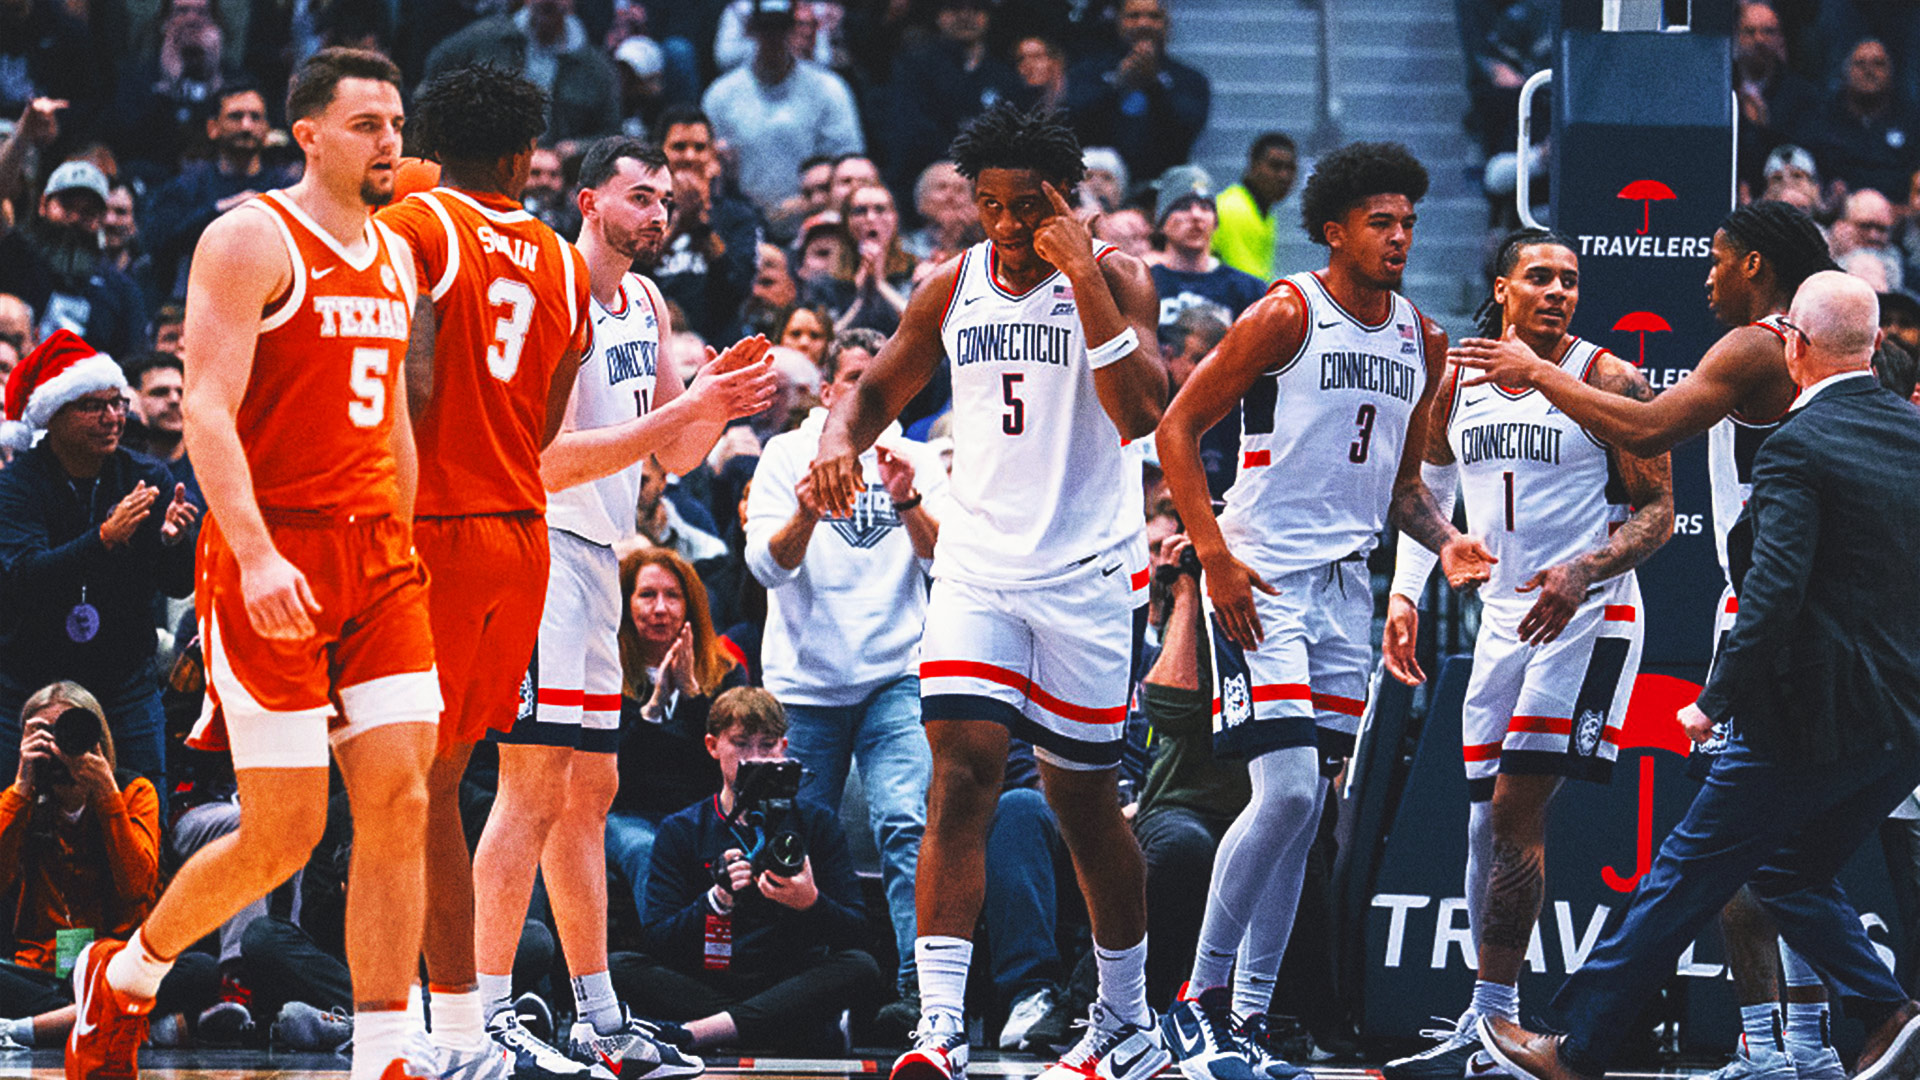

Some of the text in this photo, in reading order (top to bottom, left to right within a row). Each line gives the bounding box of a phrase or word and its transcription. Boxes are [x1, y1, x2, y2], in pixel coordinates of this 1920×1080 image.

[1578, 235, 1711, 258] TRAVELERS
[313, 295, 408, 341] TEXAS
[487, 277, 537, 383] 3
[957, 322, 1071, 368] CONNECTICUT
[348, 347, 390, 428] 5
[633, 388, 649, 418] 11
[1002, 373, 1025, 436] 5
[1320, 351, 1416, 405] CONNECTICUT
[1348, 403, 1377, 464] 3
[1461, 422, 1563, 466] CONNECTICUT
[1503, 471, 1515, 532] 1
